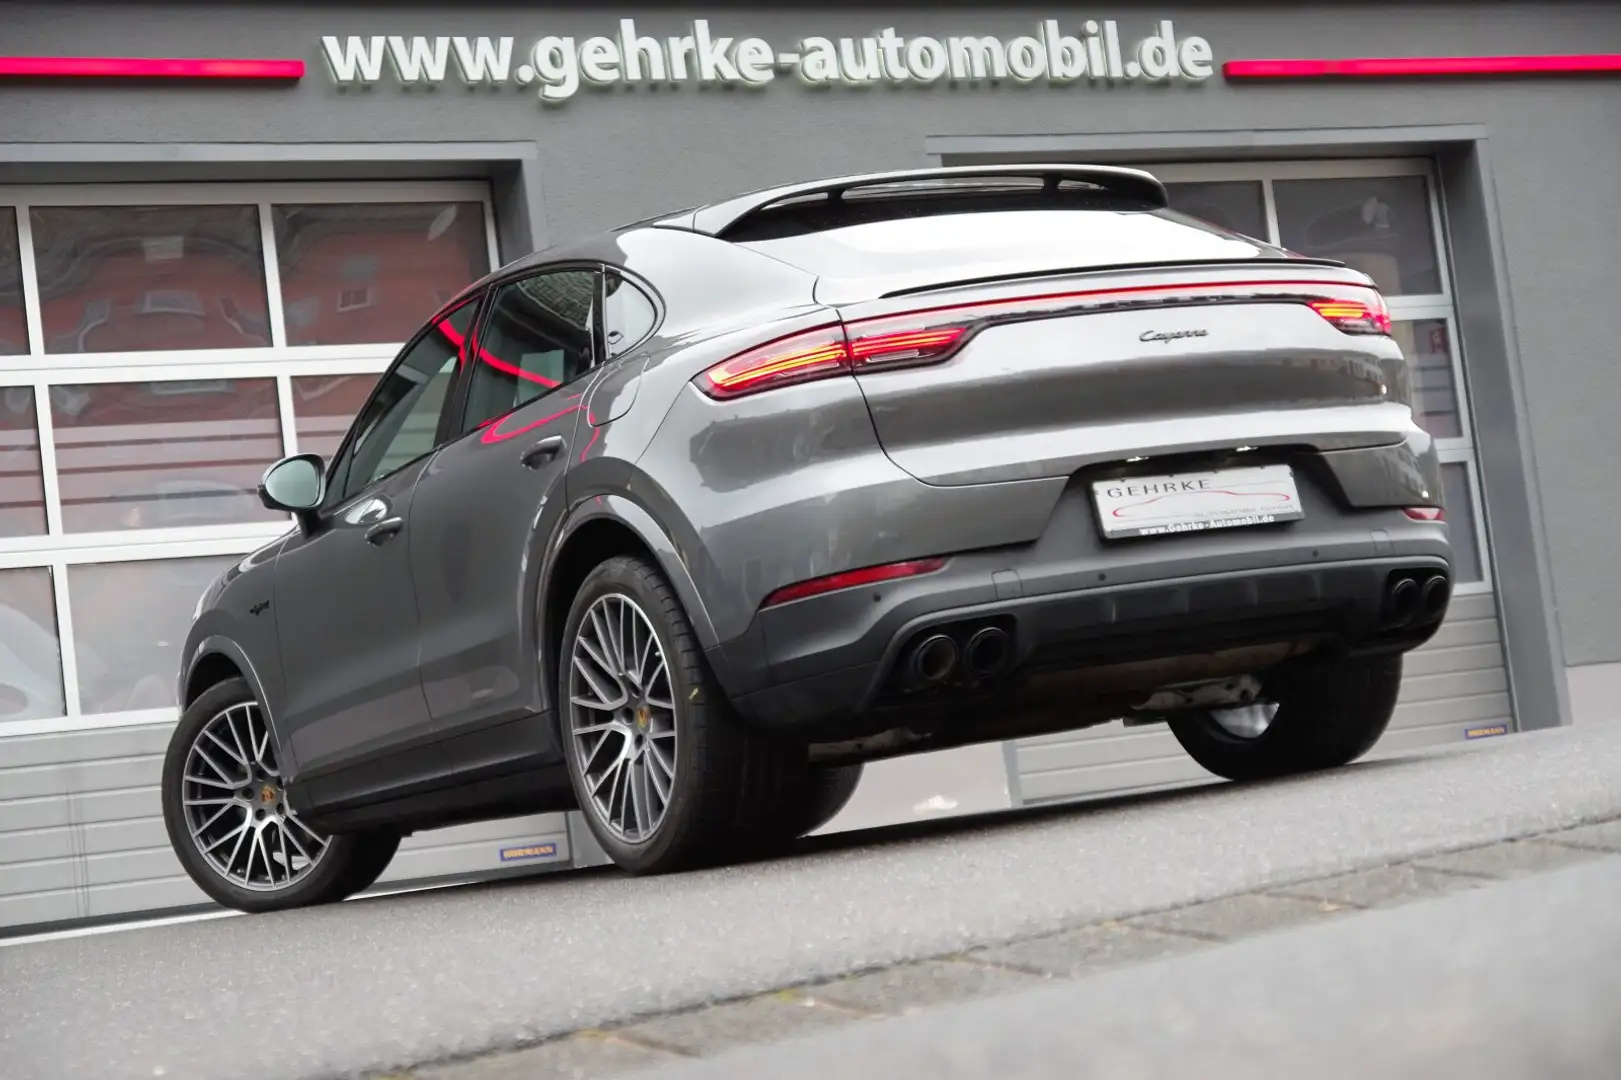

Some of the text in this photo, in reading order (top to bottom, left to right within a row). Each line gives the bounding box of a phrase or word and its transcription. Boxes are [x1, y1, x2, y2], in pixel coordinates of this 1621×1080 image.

[320, 18, 1213, 99] www.gehrke-automobil.de
[1138, 329, 1209, 344] Cayenne
[1107, 479, 1213, 499] GEHRKE
